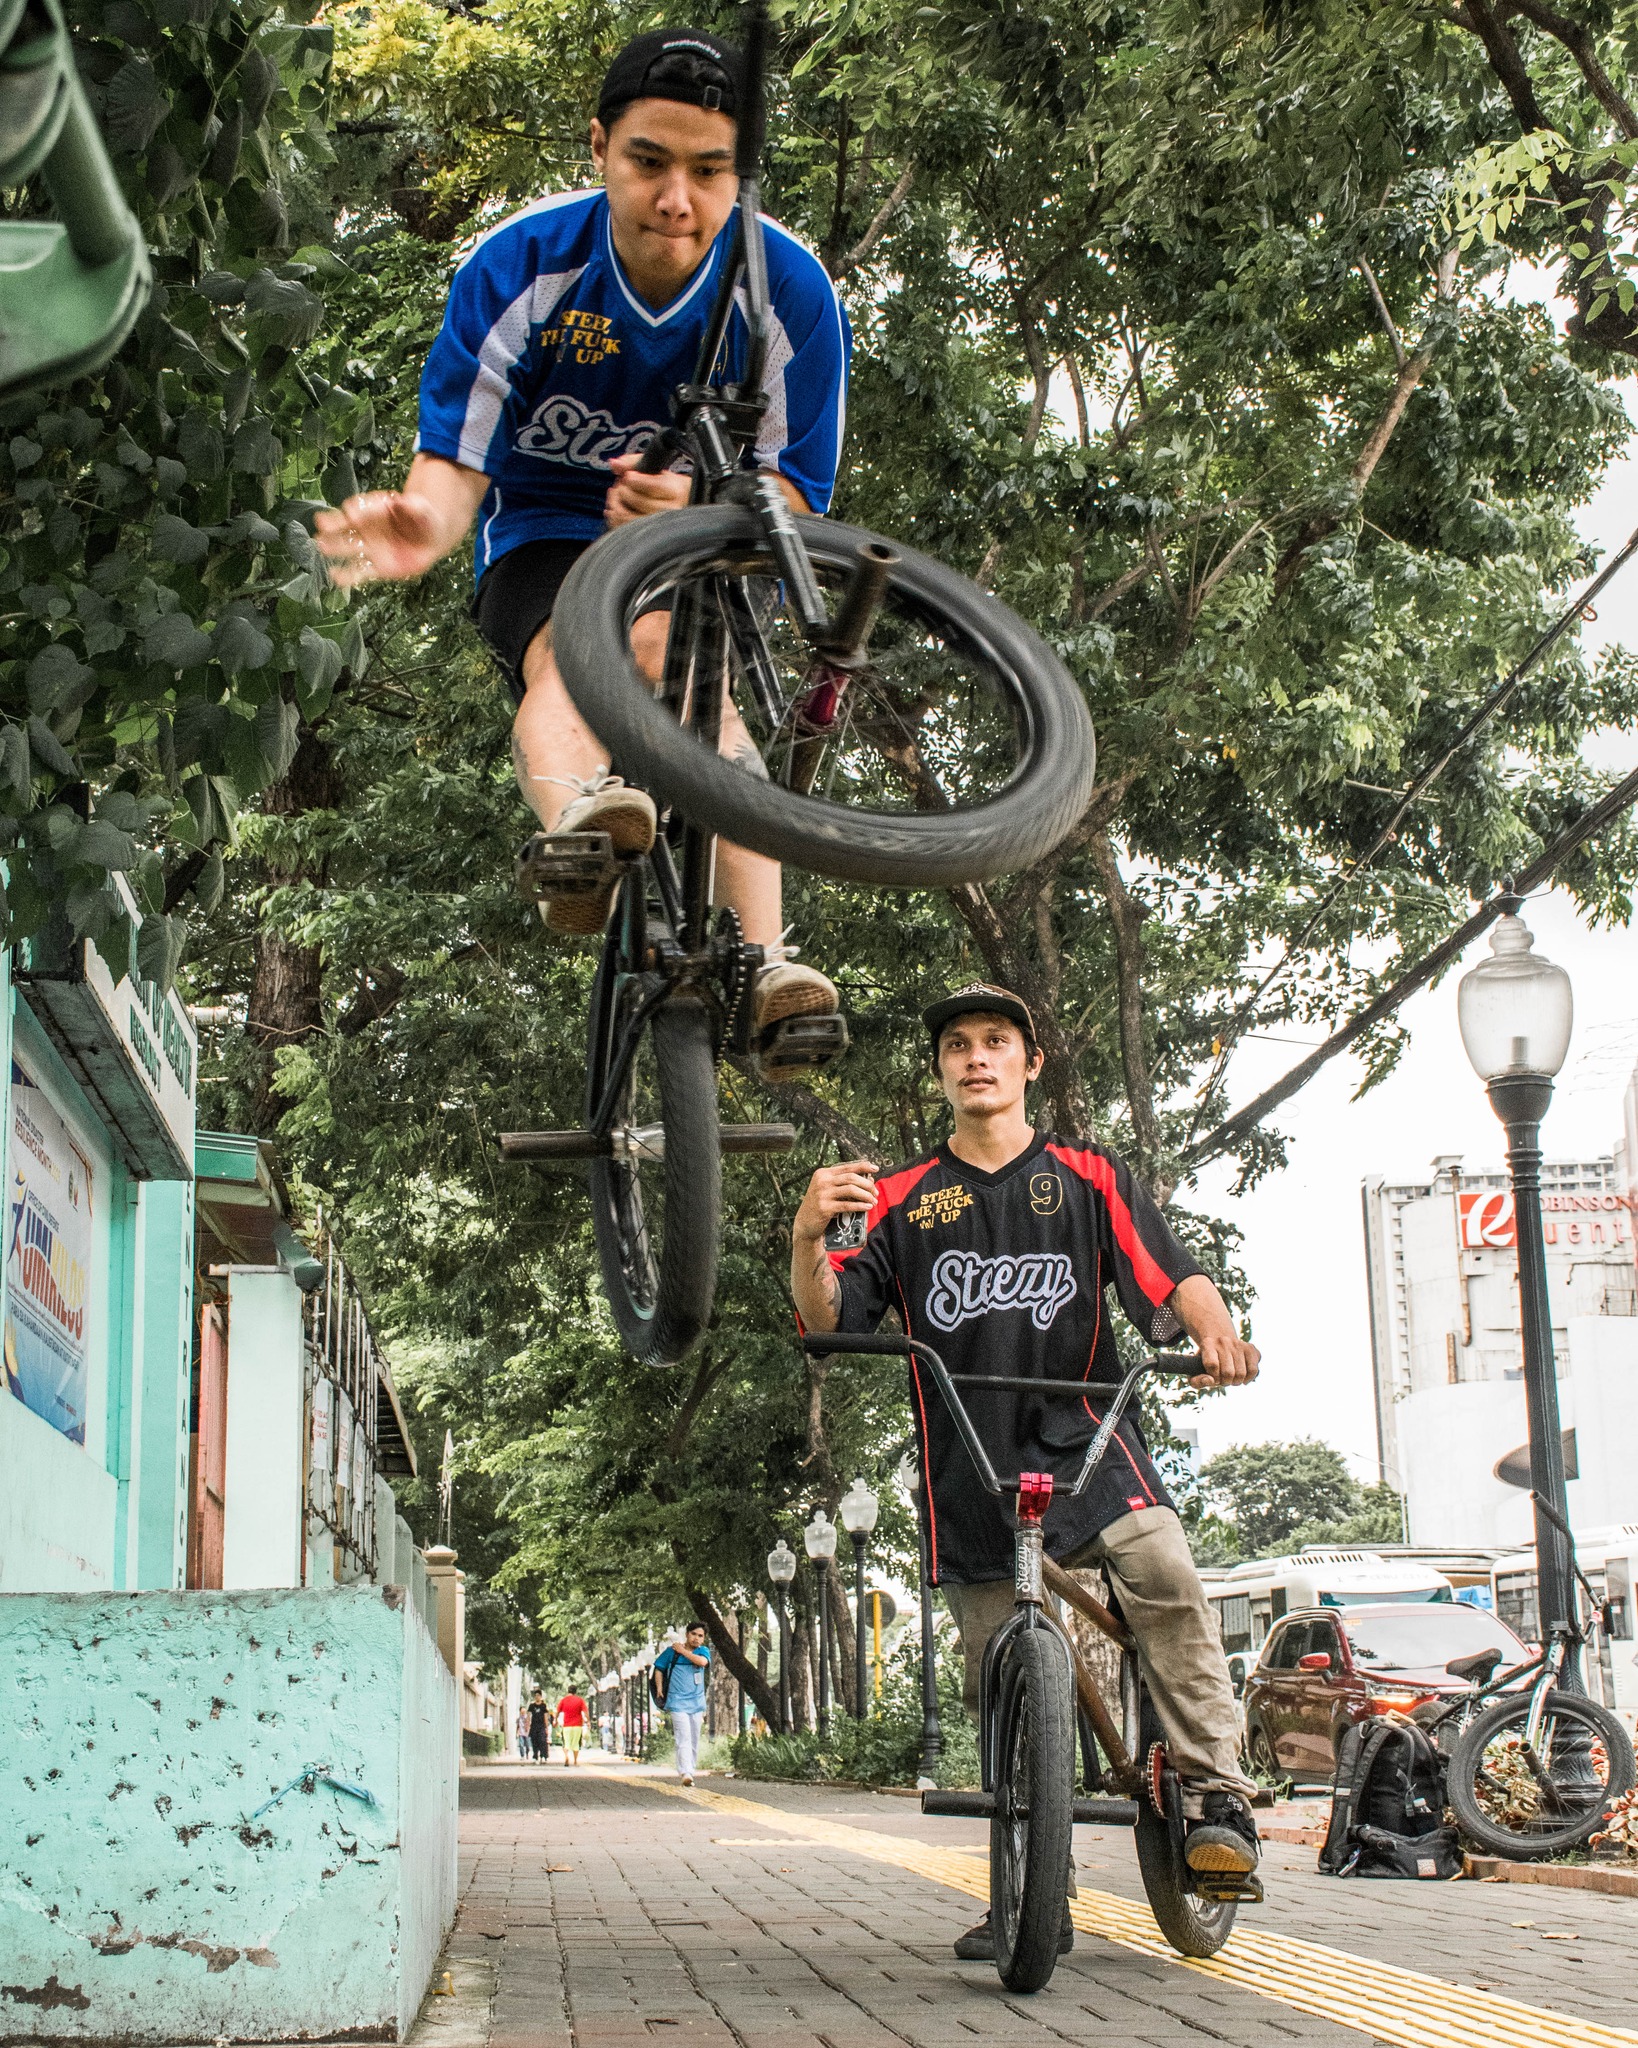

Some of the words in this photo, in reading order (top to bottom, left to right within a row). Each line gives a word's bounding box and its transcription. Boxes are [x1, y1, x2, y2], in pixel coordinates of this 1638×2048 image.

[561, 310, 612, 334] STEEZ
[576, 349, 604, 364] UP
[513, 394, 693, 473] Ste
[920, 1184, 964, 1205] STEEZ
[1029, 1173, 1063, 1215] 9
[1539, 1196, 1632, 1212] OBINSON
[907, 1205, 932, 1223] THE
[935, 1193, 974, 1214] FUCK
[941, 1209, 961, 1224] UP
[1544, 1220, 1625, 1245] uent
[925, 1249, 1077, 1333] Steezy
[1015, 1543, 1031, 1593] Steezy
